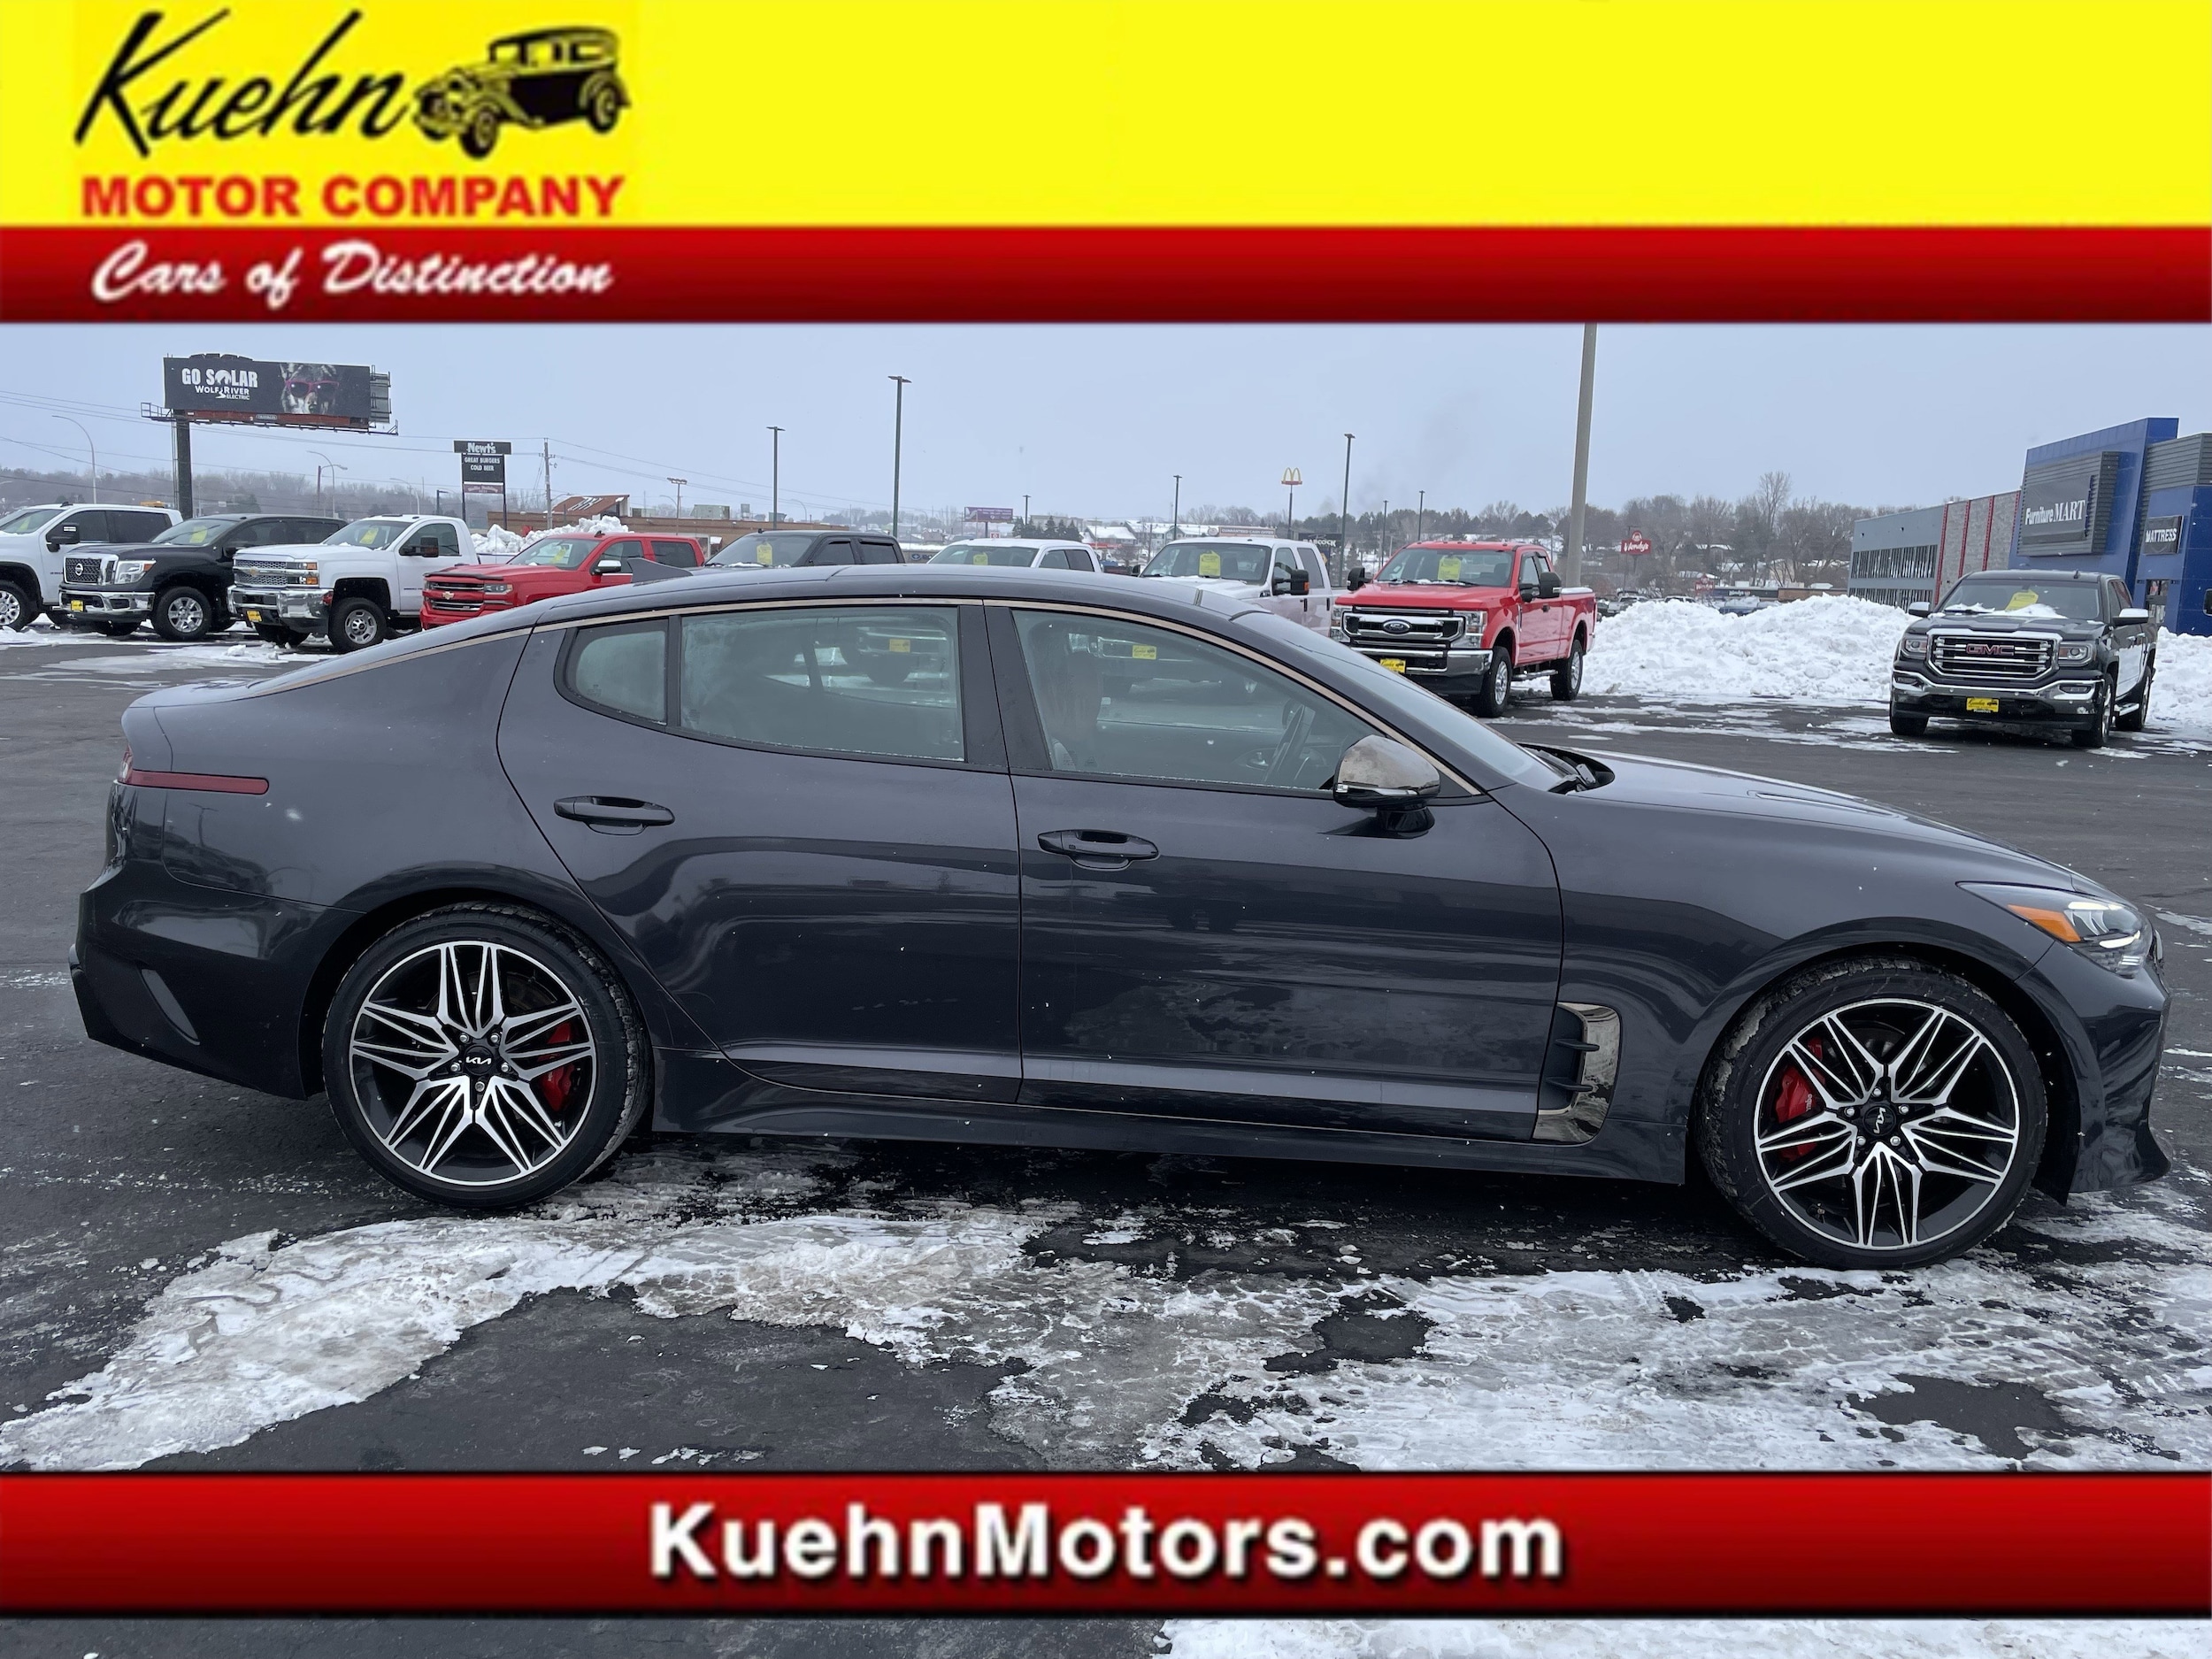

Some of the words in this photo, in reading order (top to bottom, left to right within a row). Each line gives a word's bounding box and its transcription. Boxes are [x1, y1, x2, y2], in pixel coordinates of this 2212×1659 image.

[181, 368, 201, 385] GO
[205, 368, 258, 388] SOLAR
[224, 386, 250, 395] RIVER
[466, 442, 496, 454] Newt's
[2145, 527, 2177, 543] MATTRESS
[1624, 541, 1649, 552] Wendy's
[1966, 643, 2015, 657] GMC
